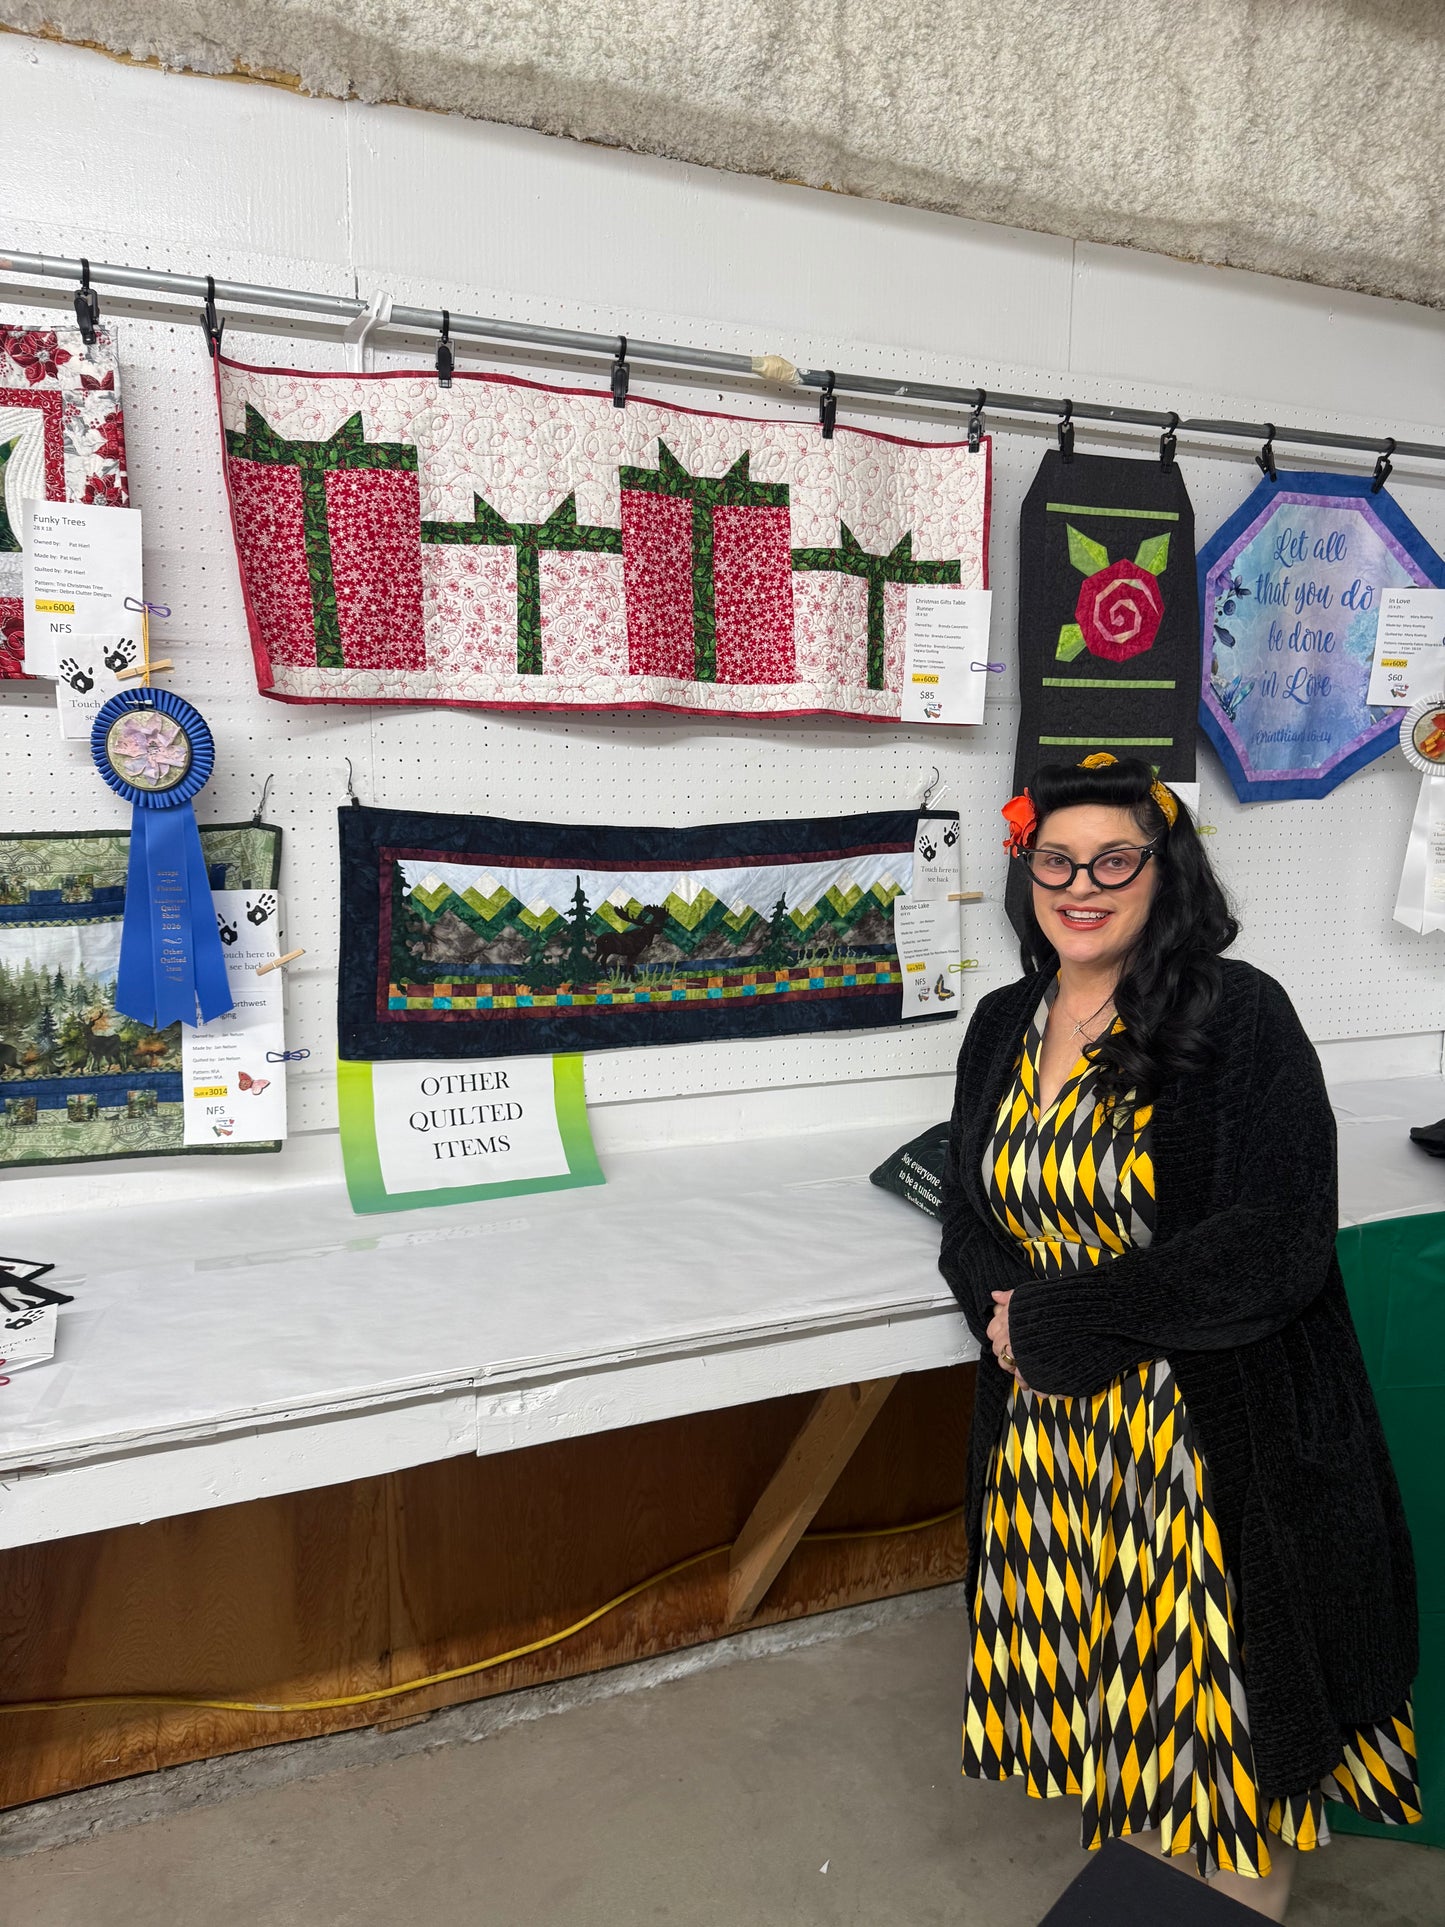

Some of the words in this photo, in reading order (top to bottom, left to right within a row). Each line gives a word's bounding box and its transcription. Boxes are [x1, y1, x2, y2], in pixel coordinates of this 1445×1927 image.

[33, 514, 60, 526] Funky
[62, 517, 86, 527] Trees
[1274, 528, 1308, 568] Let
[1314, 531, 1348, 563] all
[1254, 572, 1290, 607] that
[1295, 581, 1333, 615] you
[1340, 578, 1375, 611] do
[53, 603, 75, 612] 6004
[50, 622, 72, 634] NFS
[1268, 620, 1284, 652] be
[1288, 620, 1335, 653] done
[1388, 673, 1403, 681] $60
[1261, 670, 1279, 698] in
[1282, 667, 1332, 705] Love
[920, 690, 935, 700] $85
[69, 699, 101, 708] Touch
[223, 951, 244, 959] ouch
[233, 1000, 267, 1008] orthwest
[421, 1071, 510, 1097] OTHER
[209, 1088, 228, 1096] 3014
[206, 1106, 225, 1115] NFS
[409, 1101, 523, 1133] QUILTED
[433, 1135, 511, 1160] ITEMS
[911, 1161, 940, 1187] everyone
[899, 1170, 905, 1180] to
[905, 1173, 913, 1186] be
[912, 1181, 919, 1190] a
[918, 1185, 943, 1207] unicor
